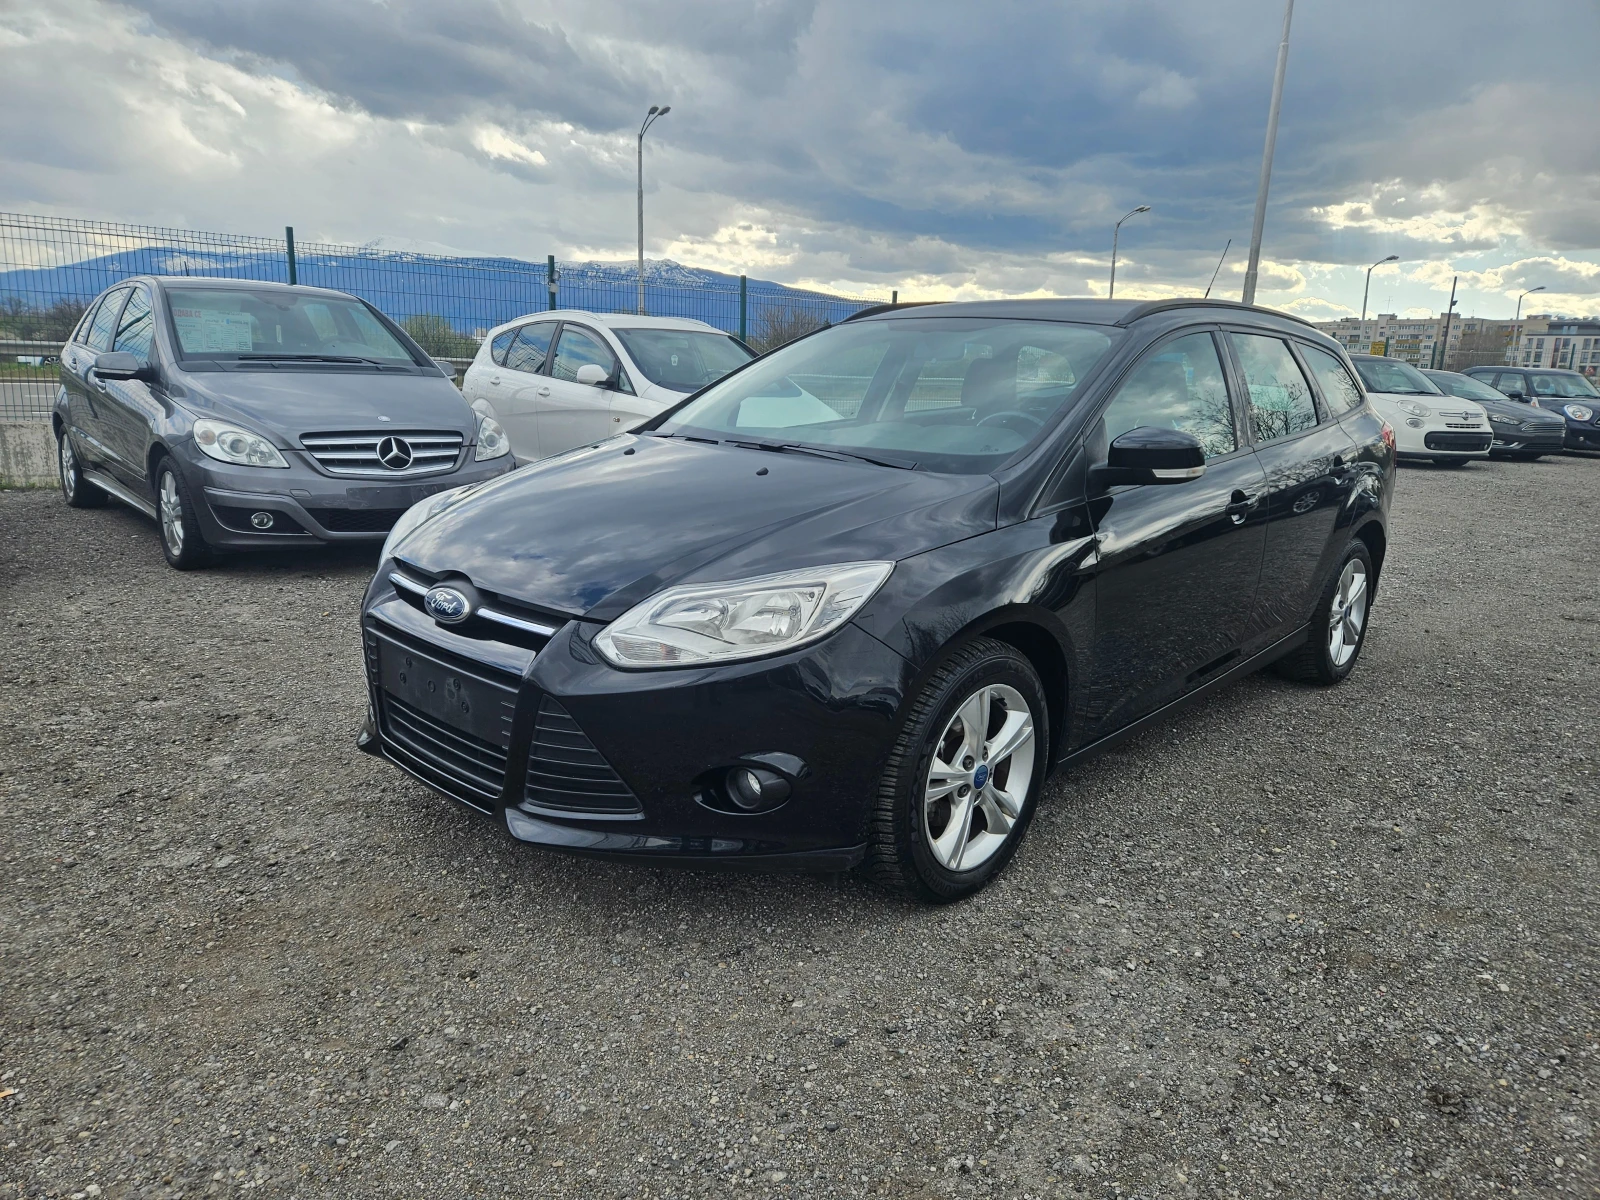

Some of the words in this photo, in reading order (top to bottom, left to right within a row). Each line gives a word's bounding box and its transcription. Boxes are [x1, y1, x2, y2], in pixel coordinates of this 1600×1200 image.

[173, 308, 193, 318] ОДАВА
[430, 591, 457, 614] Ford
[923, 867, 960, 893] KUMHO
